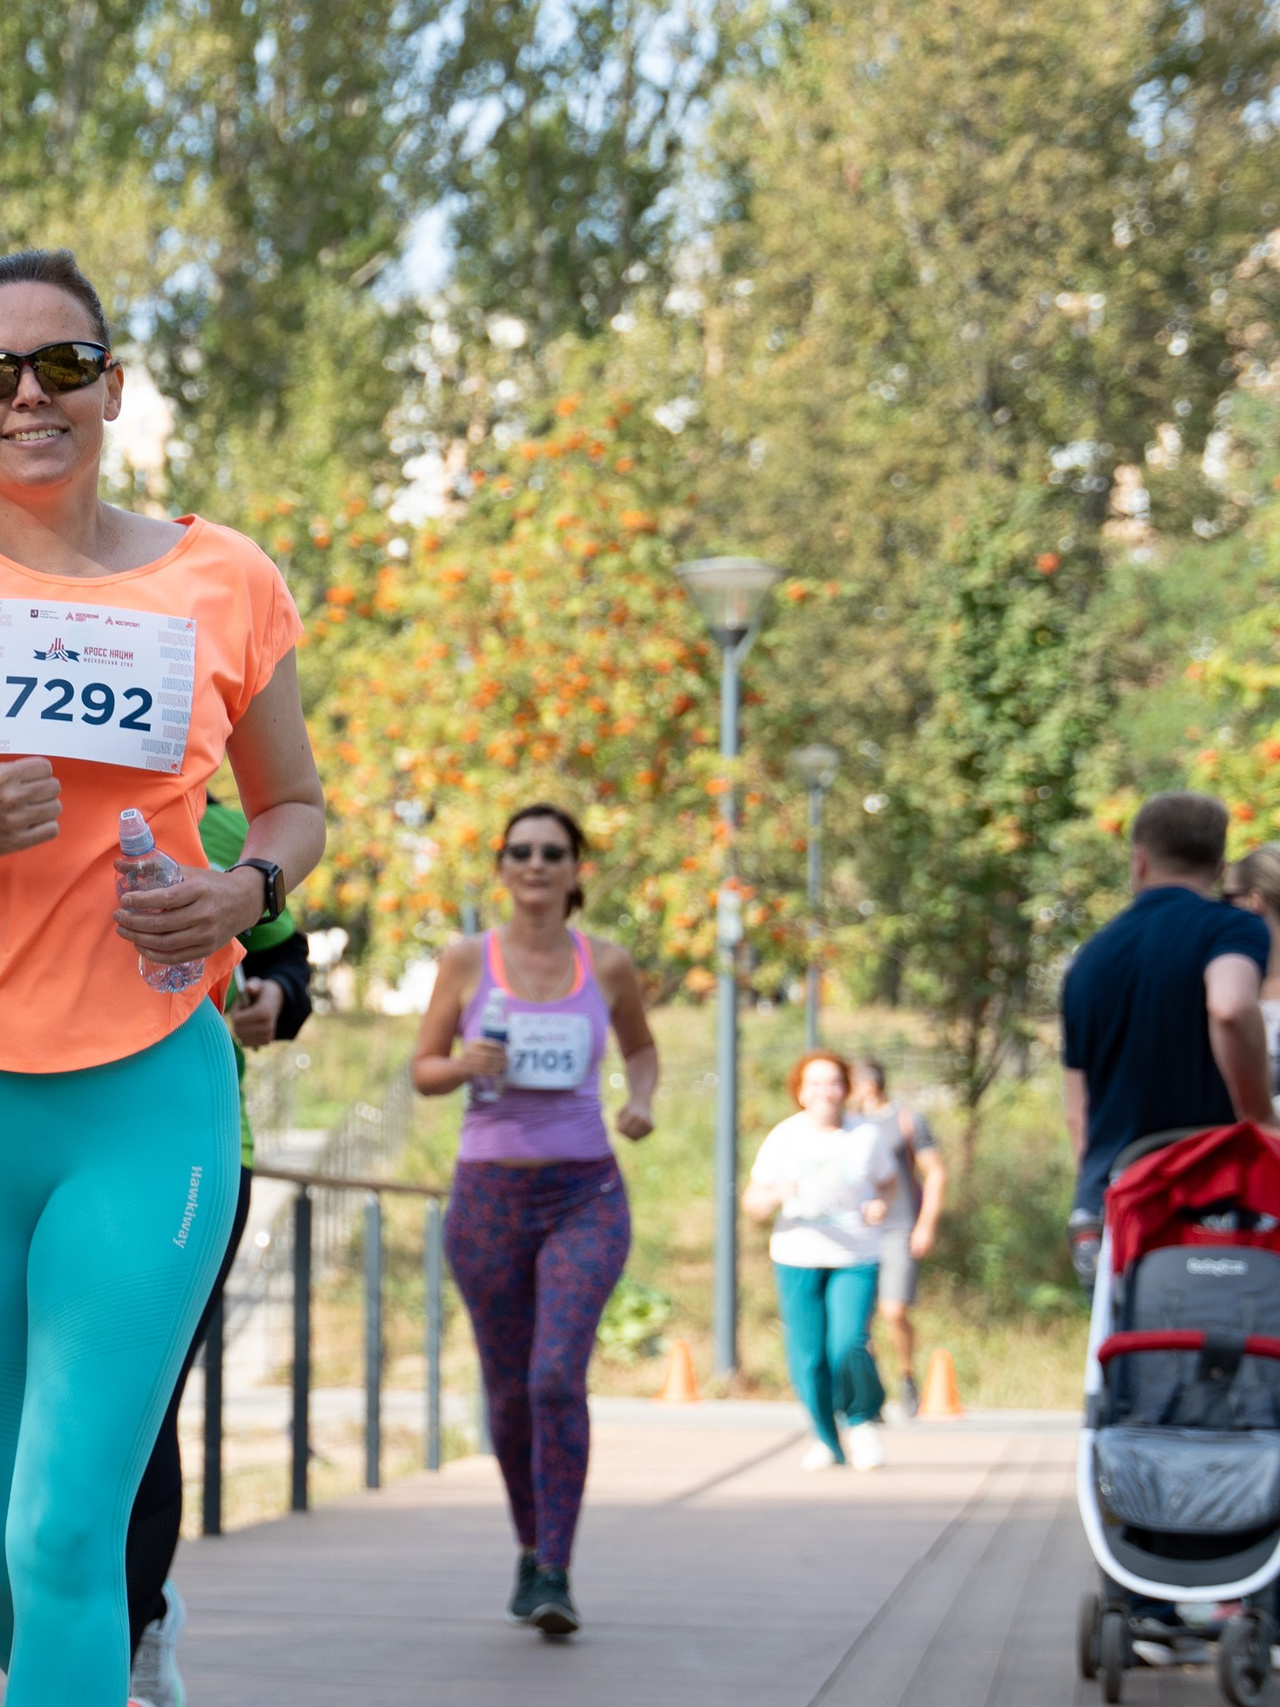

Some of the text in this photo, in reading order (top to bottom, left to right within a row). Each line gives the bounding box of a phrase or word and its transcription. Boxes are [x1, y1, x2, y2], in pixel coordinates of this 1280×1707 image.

[83, 646, 134, 661] КРОСС НАЦИИ
[5, 675, 153, 733] 7292
[514, 1048, 574, 1073] 7105
[172, 1166, 203, 1249] Hawkiway
